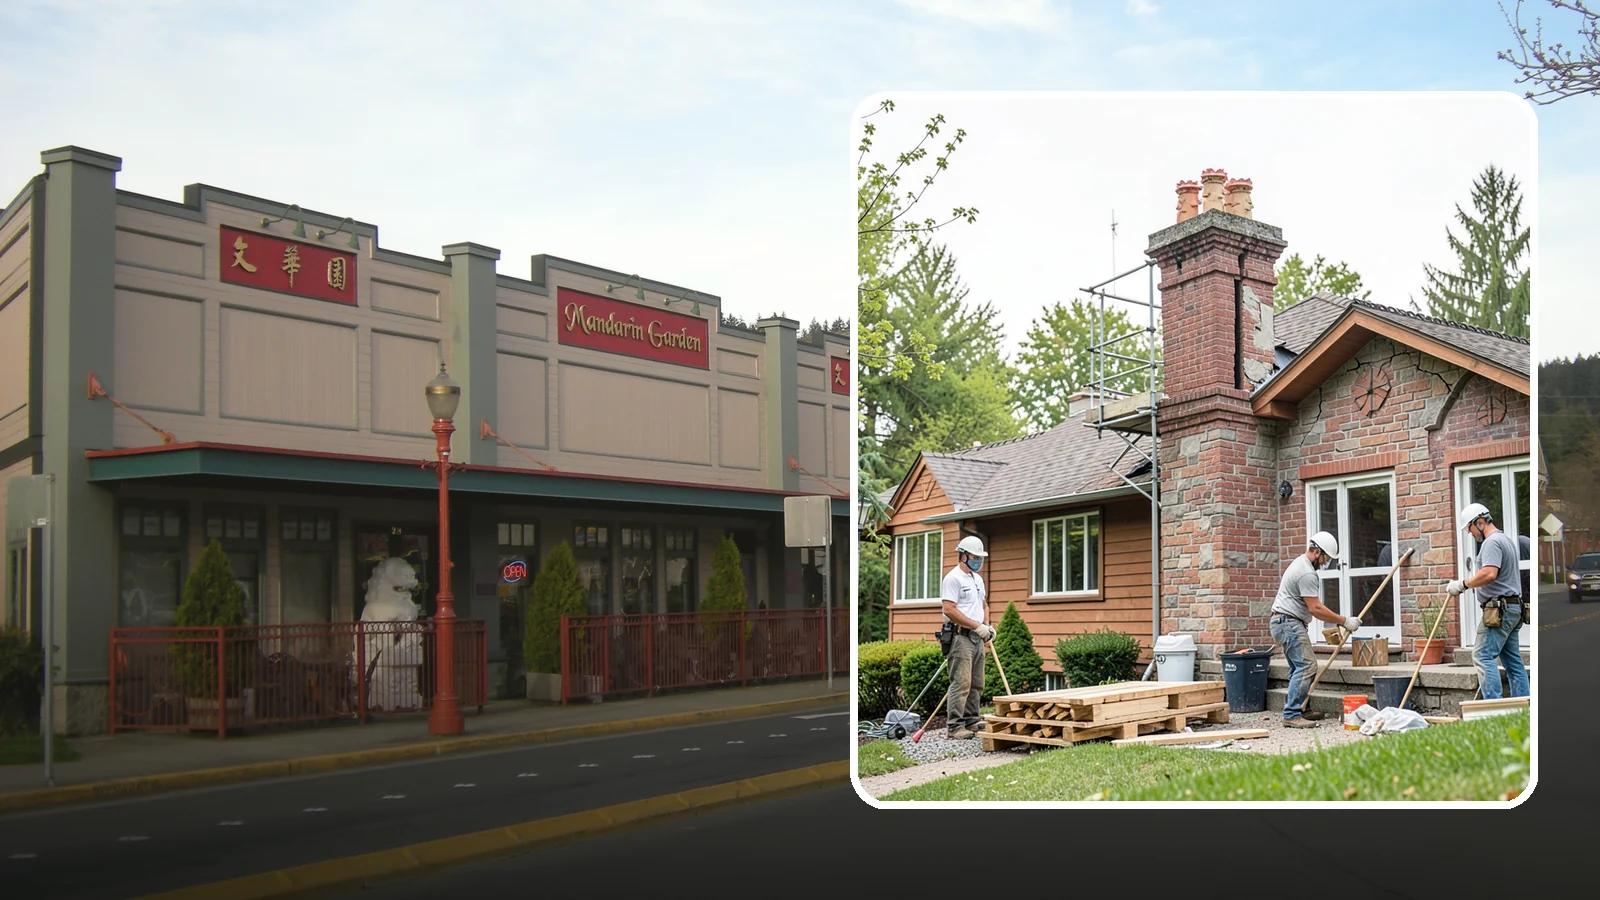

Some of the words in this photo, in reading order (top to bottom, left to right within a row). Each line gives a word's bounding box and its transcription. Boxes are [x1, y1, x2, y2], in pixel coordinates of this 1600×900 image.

[230, 235, 346, 291] 文華園
[564, 302, 644, 341] Mandarin
[647, 320, 701, 352] Garden
[503, 565, 527, 578] OPEN
